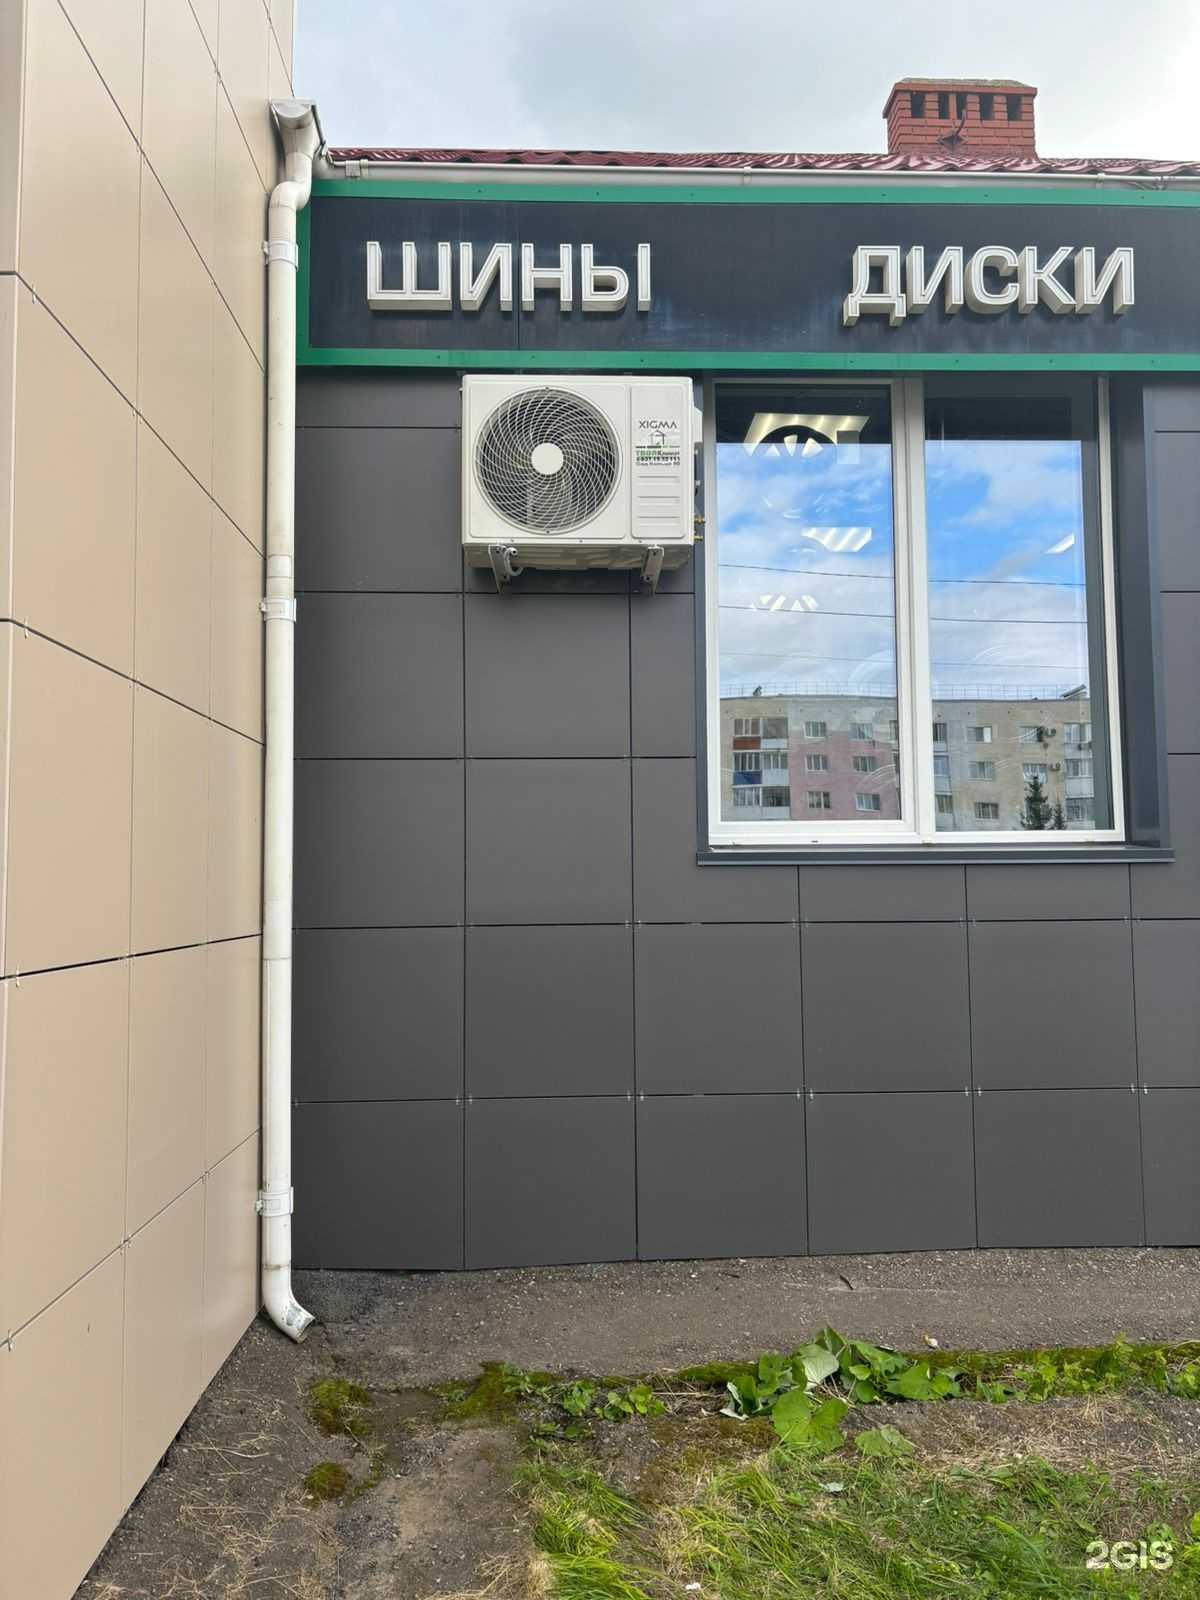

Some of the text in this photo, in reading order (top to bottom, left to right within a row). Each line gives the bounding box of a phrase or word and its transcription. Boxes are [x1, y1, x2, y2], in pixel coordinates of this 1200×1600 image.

[366, 241, 1135, 325] ШИНЫ ДИСКИ
[638, 420, 678, 429] XIGMA
